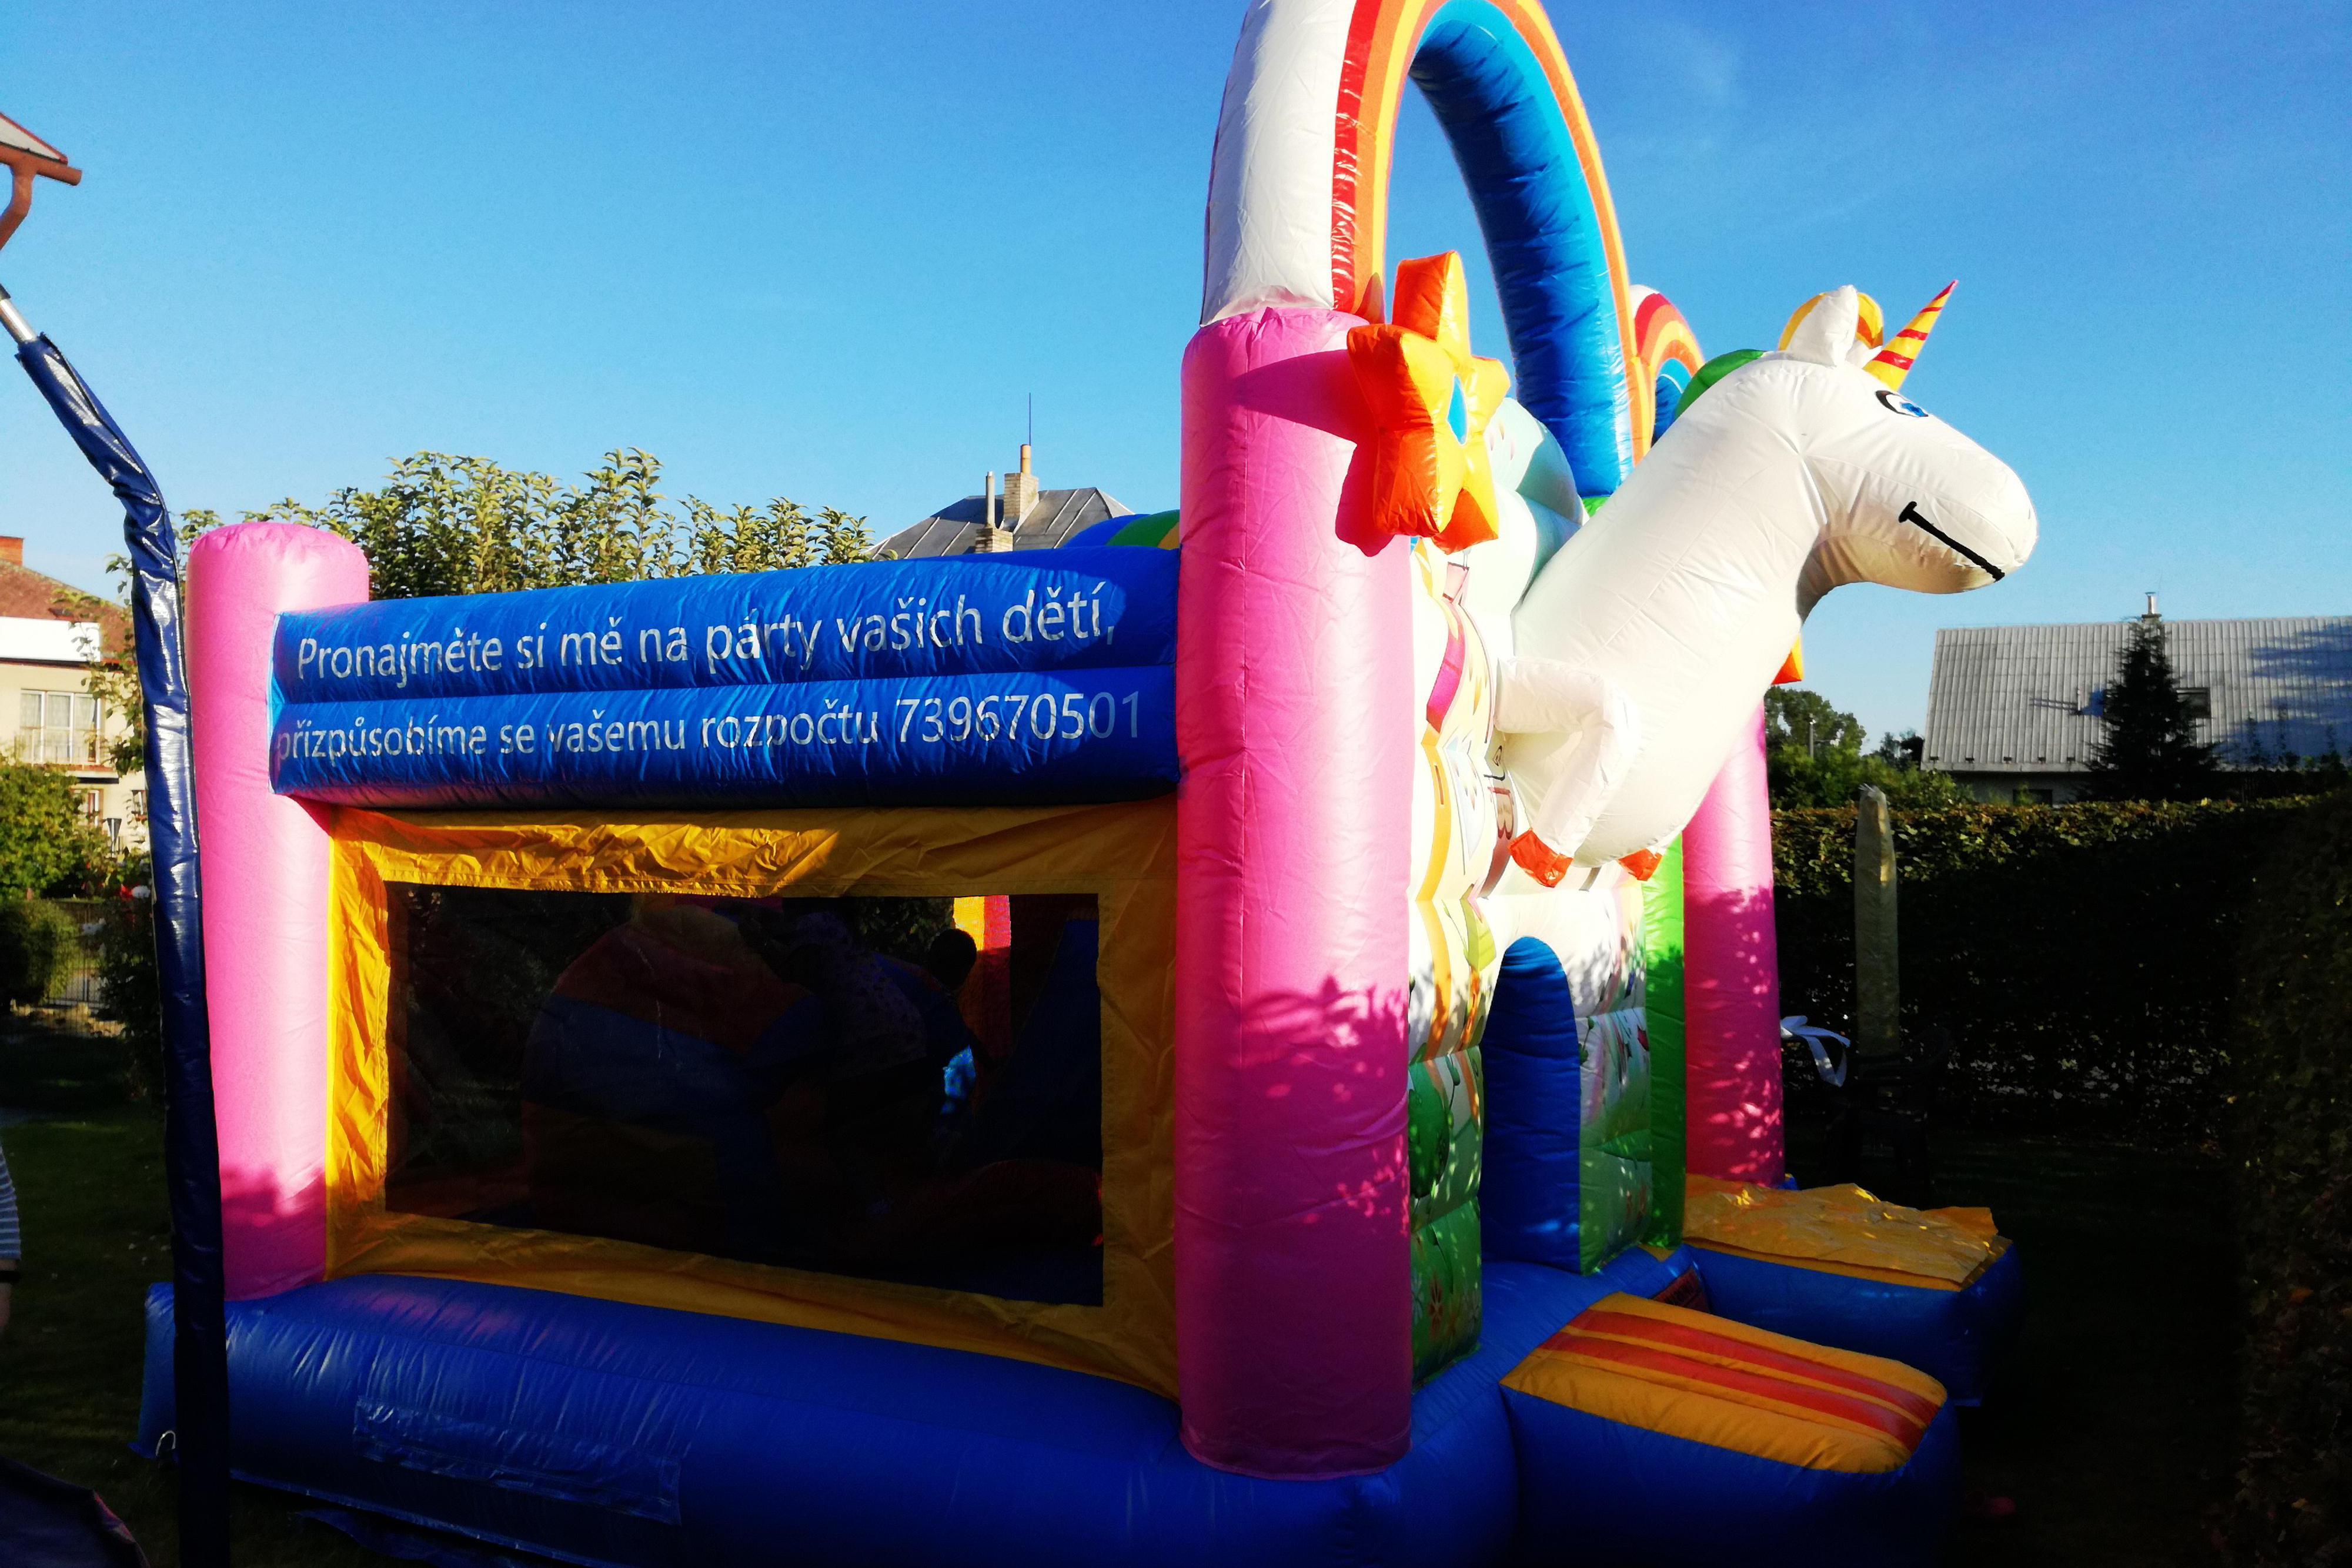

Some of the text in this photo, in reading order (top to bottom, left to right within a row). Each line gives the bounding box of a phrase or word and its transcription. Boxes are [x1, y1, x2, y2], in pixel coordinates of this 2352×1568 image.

[298, 581, 1115, 689] Pronajměte si mě na párty vašich dětí,
[276, 690, 1140, 767] přizpůsobíme se vašemu rozpočtu 739670501
